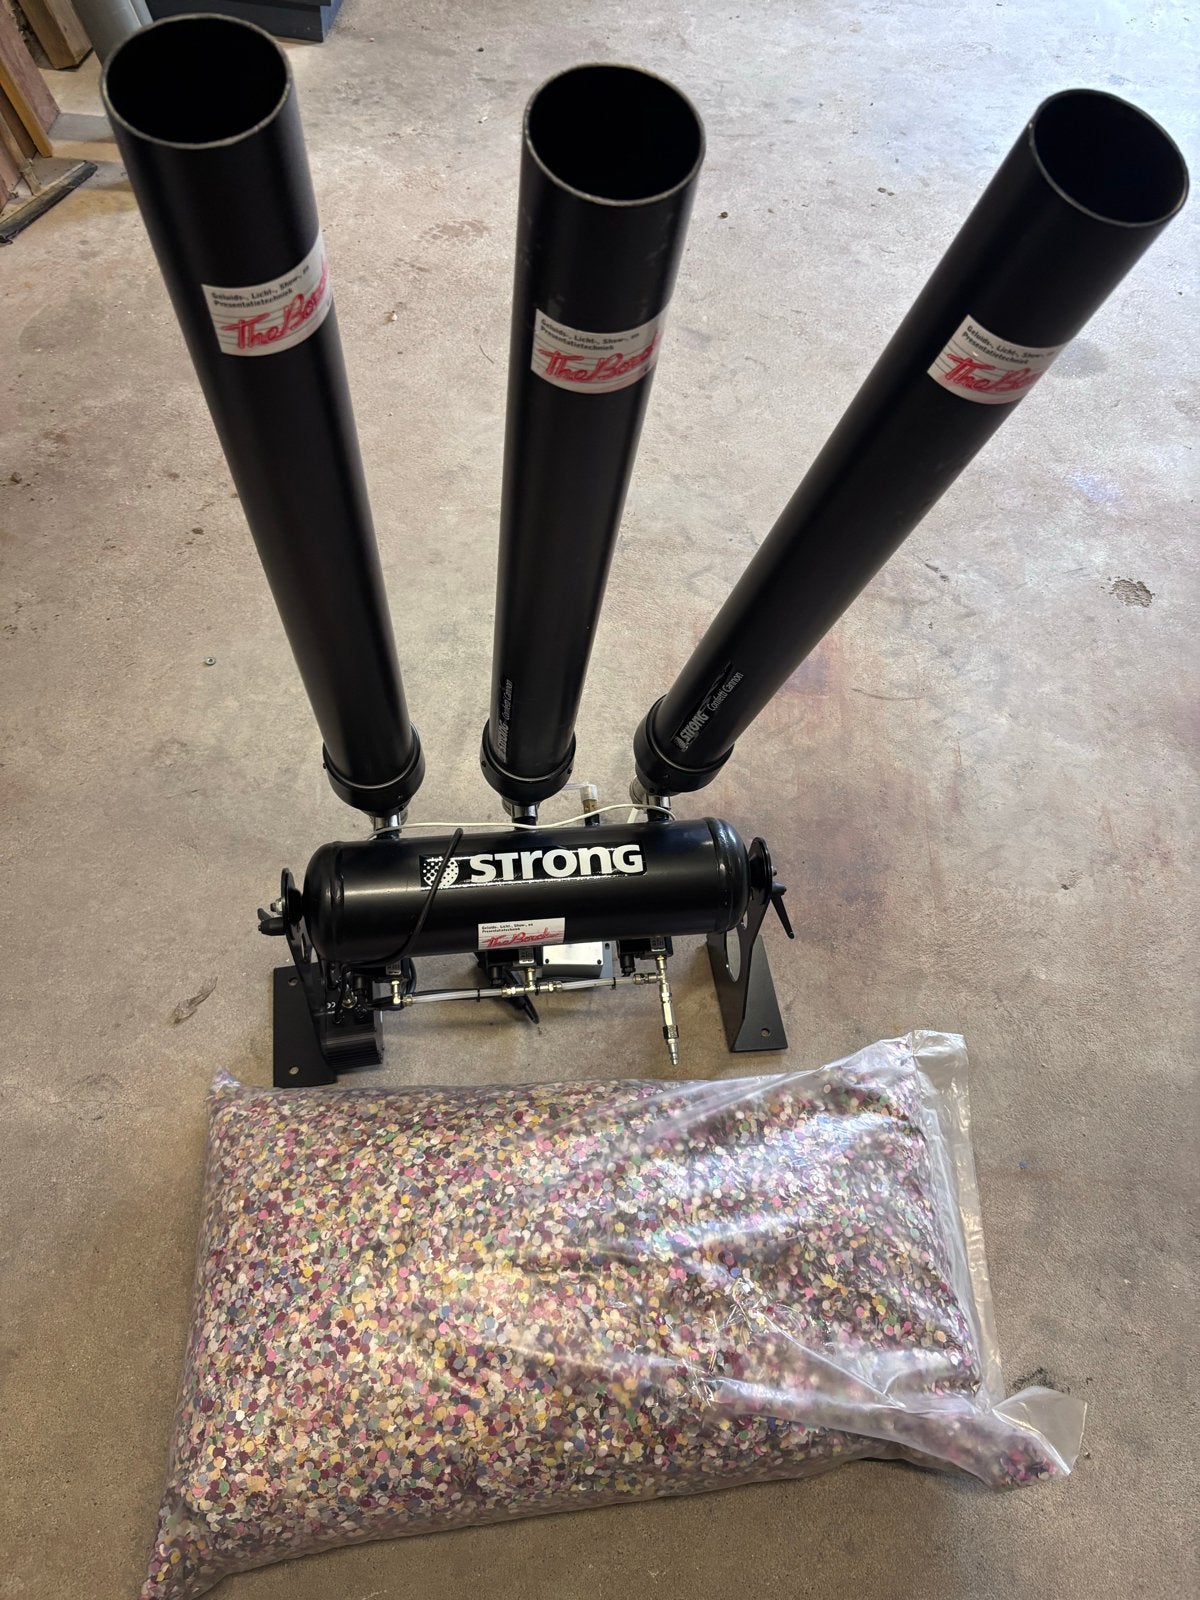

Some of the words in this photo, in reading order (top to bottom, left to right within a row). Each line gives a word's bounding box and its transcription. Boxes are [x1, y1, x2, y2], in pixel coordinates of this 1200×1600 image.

[221, 312, 280, 349] The
[962, 331, 1029, 364] Presentatietechniek
[538, 347, 592, 382] The
[945, 353, 996, 391] The
[707, 689, 727, 711] Confetti
[722, 672, 744, 693] Cannon
[482, 935, 511, 948] The
